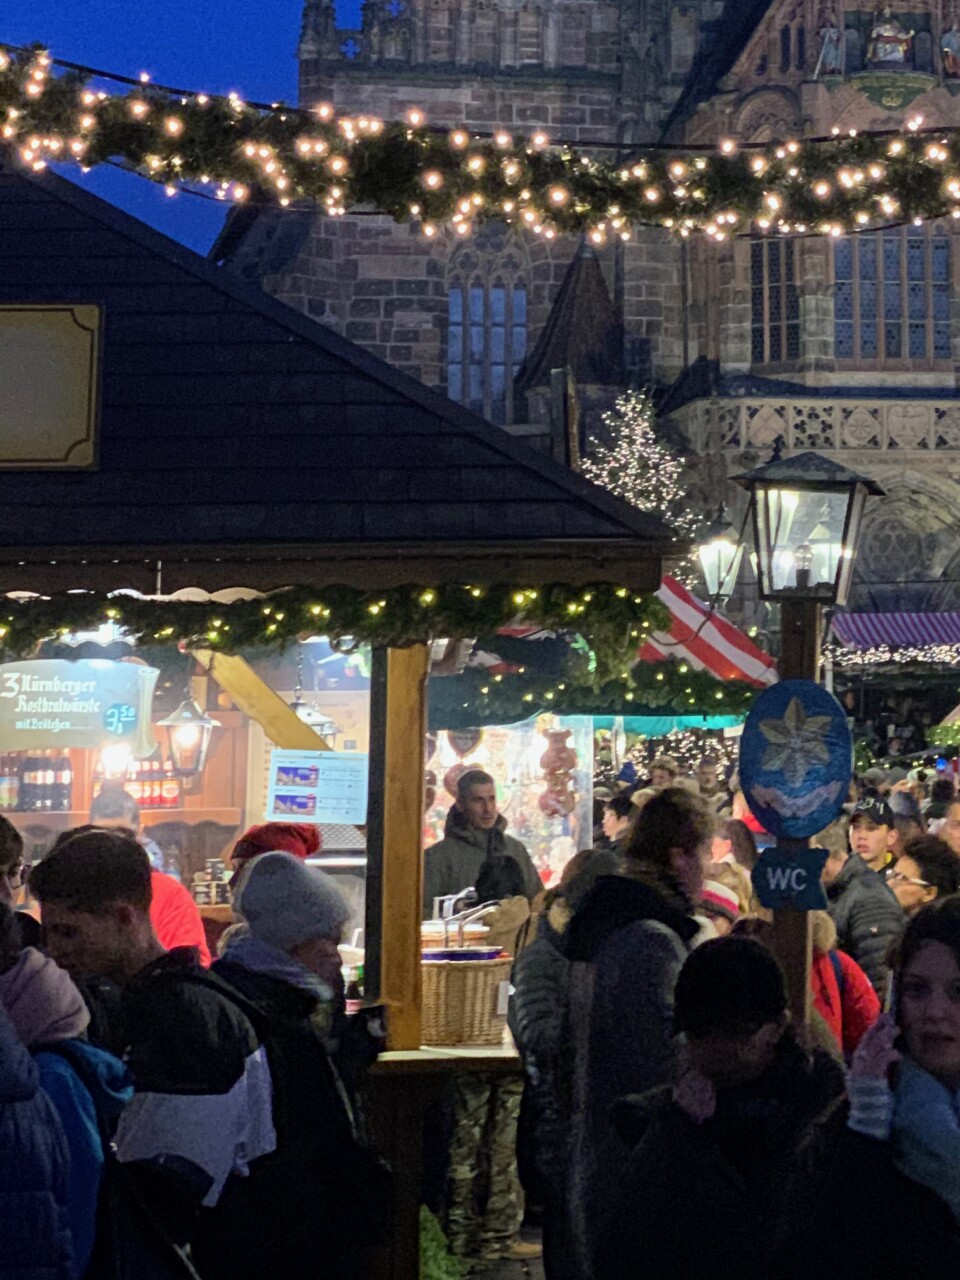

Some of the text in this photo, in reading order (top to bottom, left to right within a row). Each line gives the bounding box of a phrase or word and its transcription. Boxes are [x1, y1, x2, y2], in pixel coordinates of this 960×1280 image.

[0, 673, 96, 697] 3 Nürnberger
[14, 695, 100, 712] Rostbratwürste
[767, 867, 807, 890] WC
